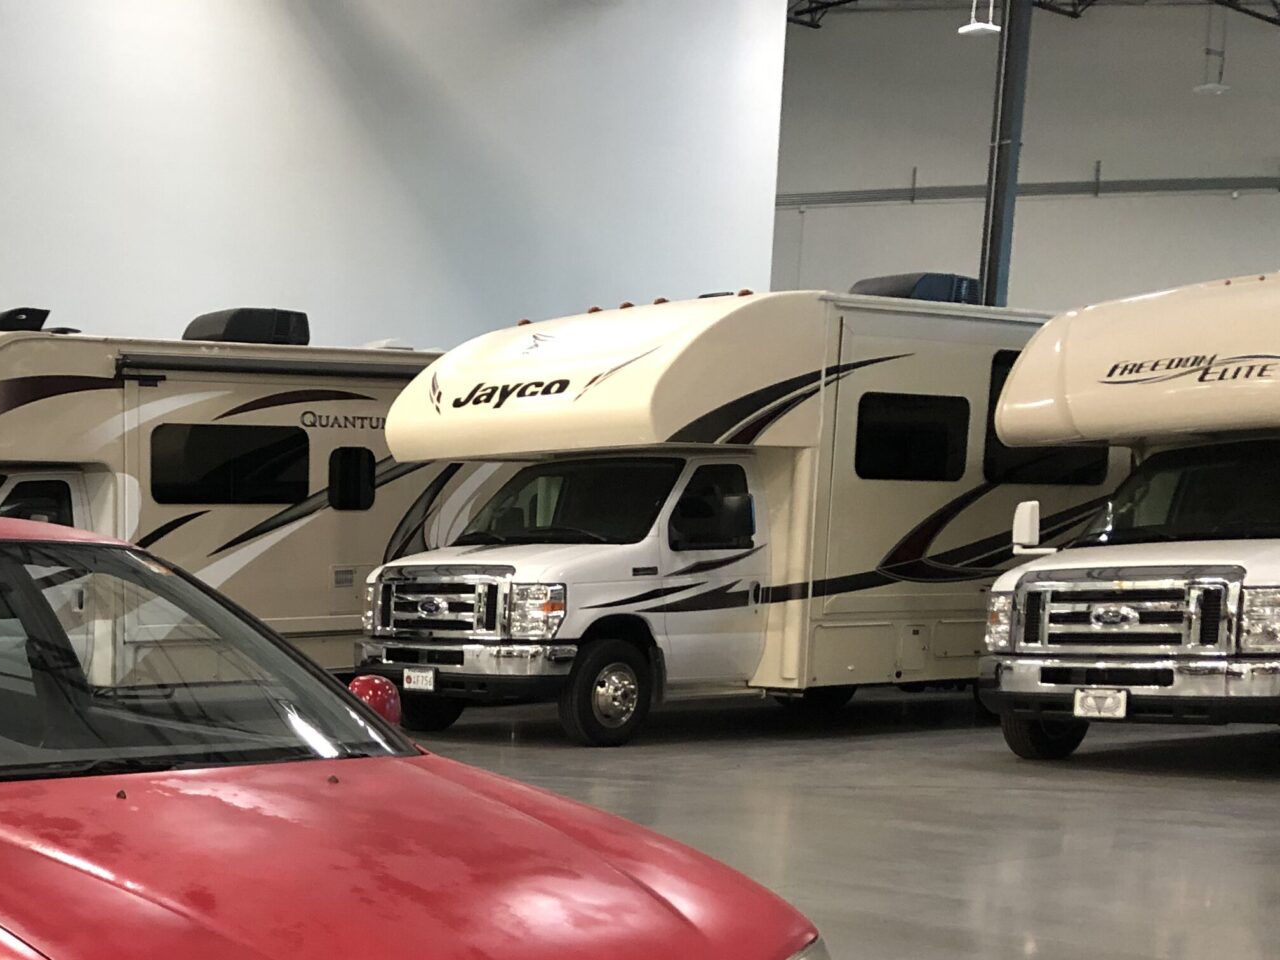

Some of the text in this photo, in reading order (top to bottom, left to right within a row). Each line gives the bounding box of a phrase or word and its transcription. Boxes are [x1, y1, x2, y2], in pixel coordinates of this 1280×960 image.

[1106, 354, 1218, 378] FREEDOM
[1198, 363, 1279, 383] ELITE
[452, 379, 570, 409] Jayco
